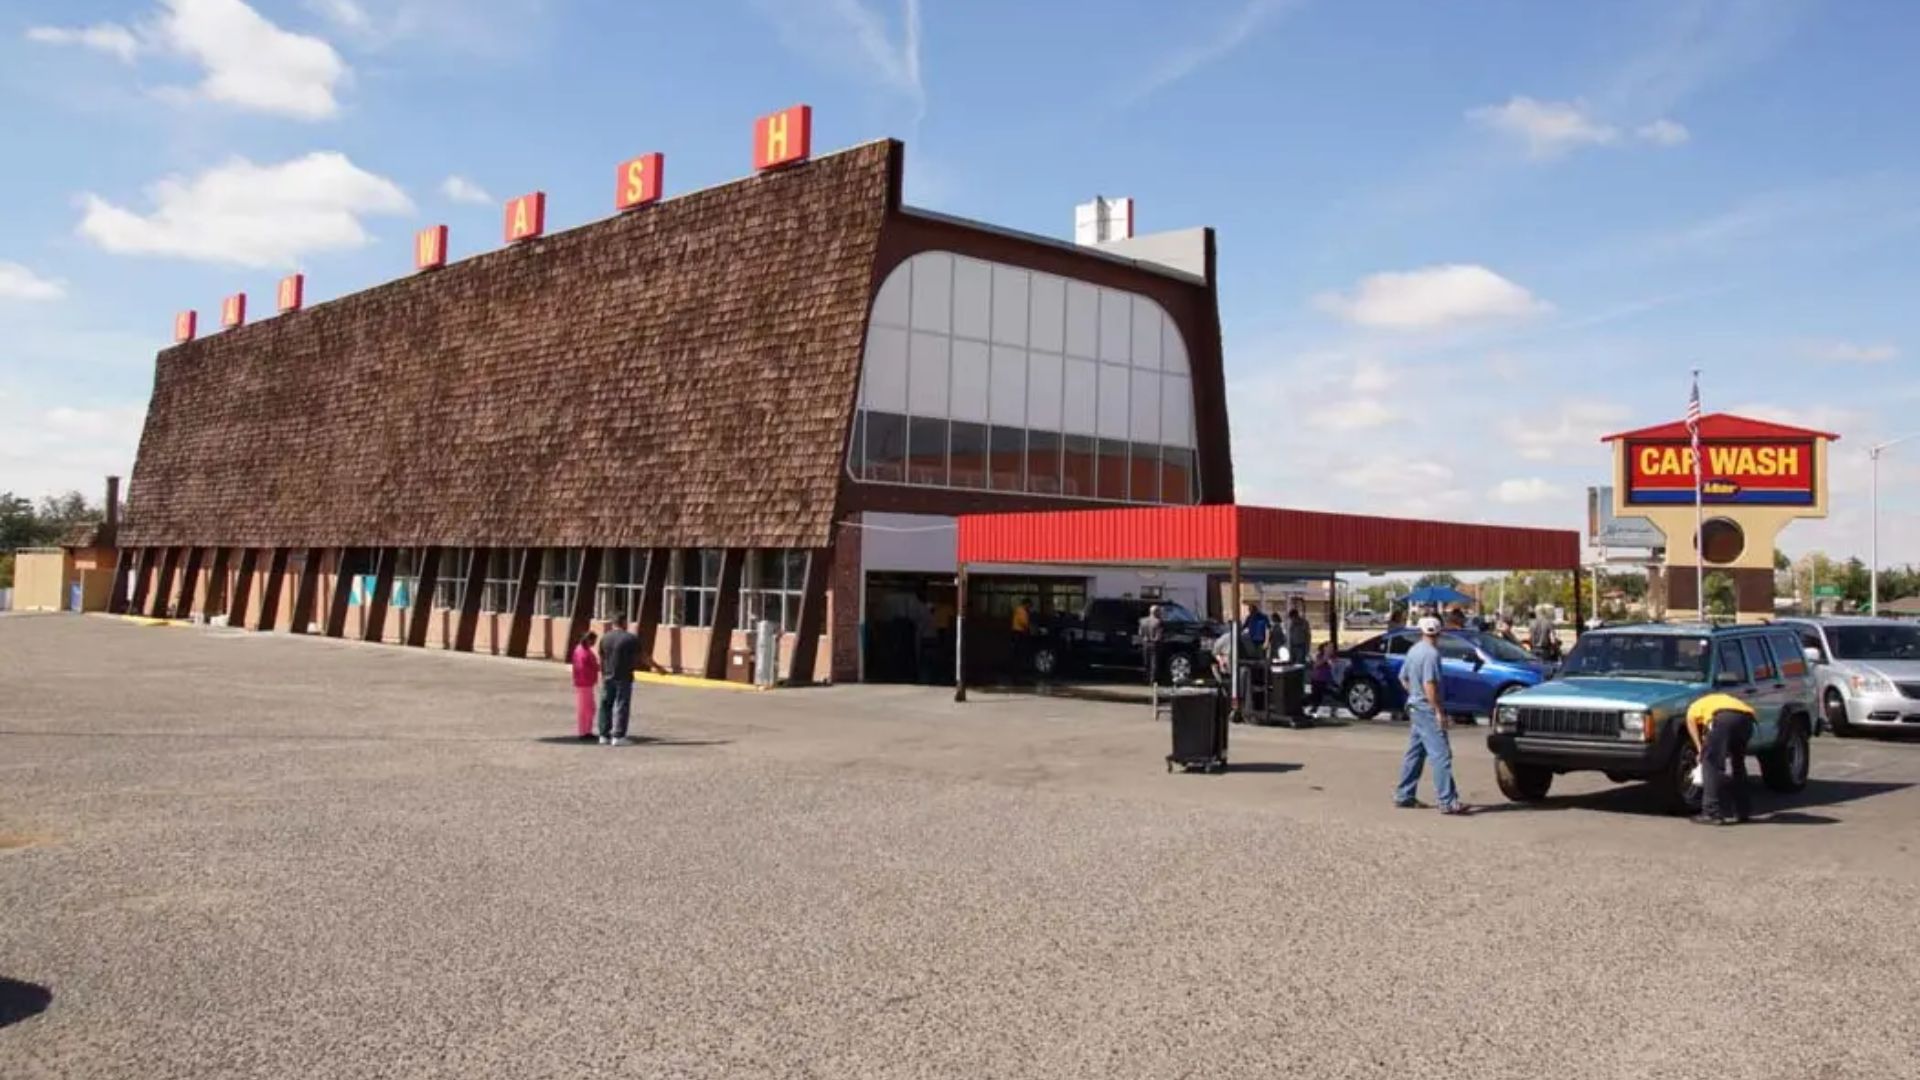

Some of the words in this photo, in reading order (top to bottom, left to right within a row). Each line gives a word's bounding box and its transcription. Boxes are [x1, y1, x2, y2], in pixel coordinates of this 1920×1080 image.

[419, 112, 788, 265] WASH
[1641, 447, 1699, 475] CAR
[1708, 447, 1798, 475] WASH
